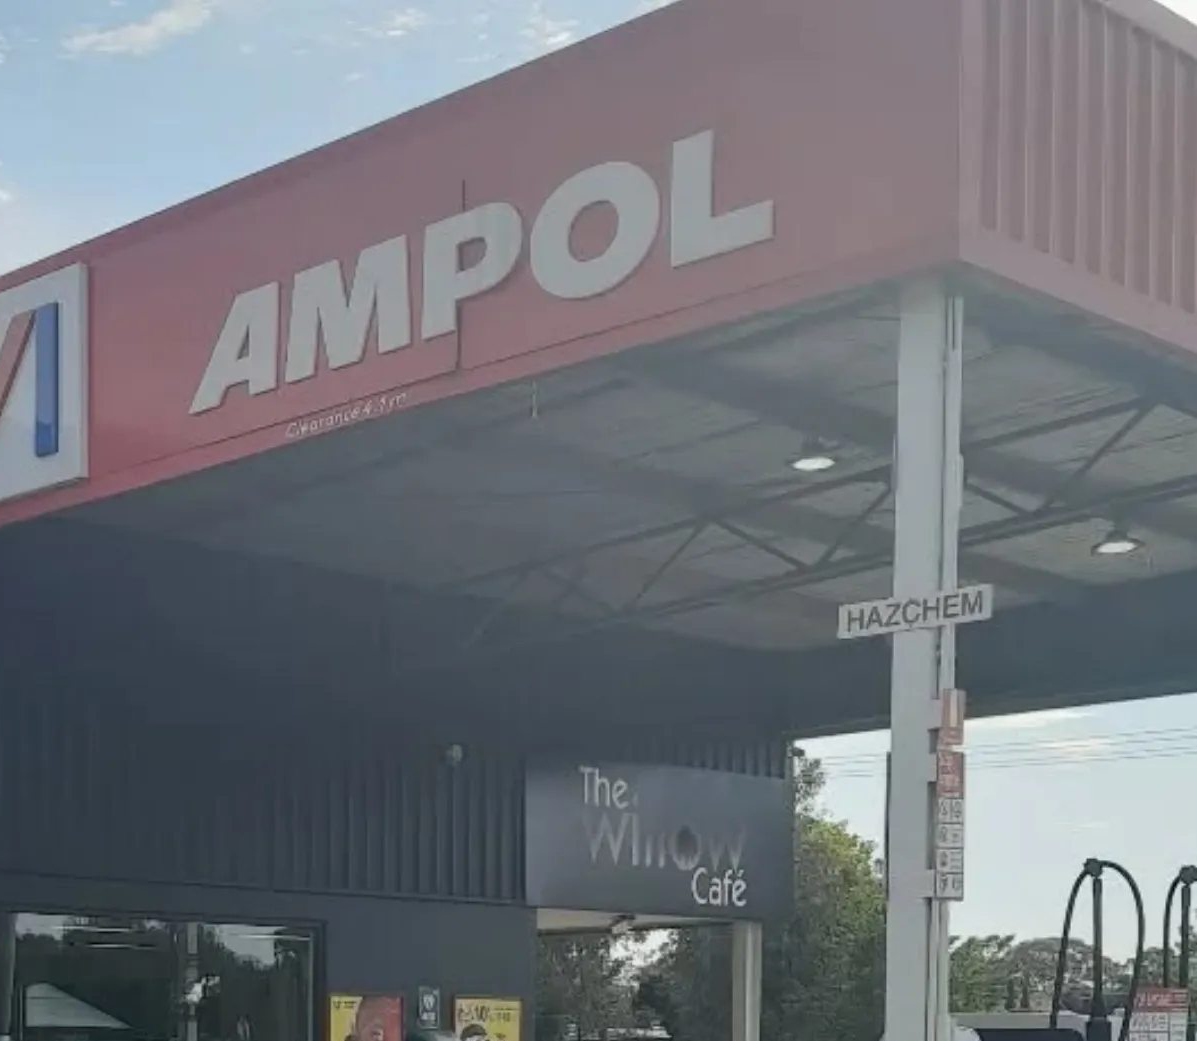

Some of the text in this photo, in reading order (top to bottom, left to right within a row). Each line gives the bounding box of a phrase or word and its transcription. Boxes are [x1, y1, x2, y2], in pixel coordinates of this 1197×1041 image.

[190, 130, 775, 415] AMPOL
[846, 589, 983, 633] HAZCHEM
[579, 765, 629, 809] The
[691, 867, 747, 908] Café
